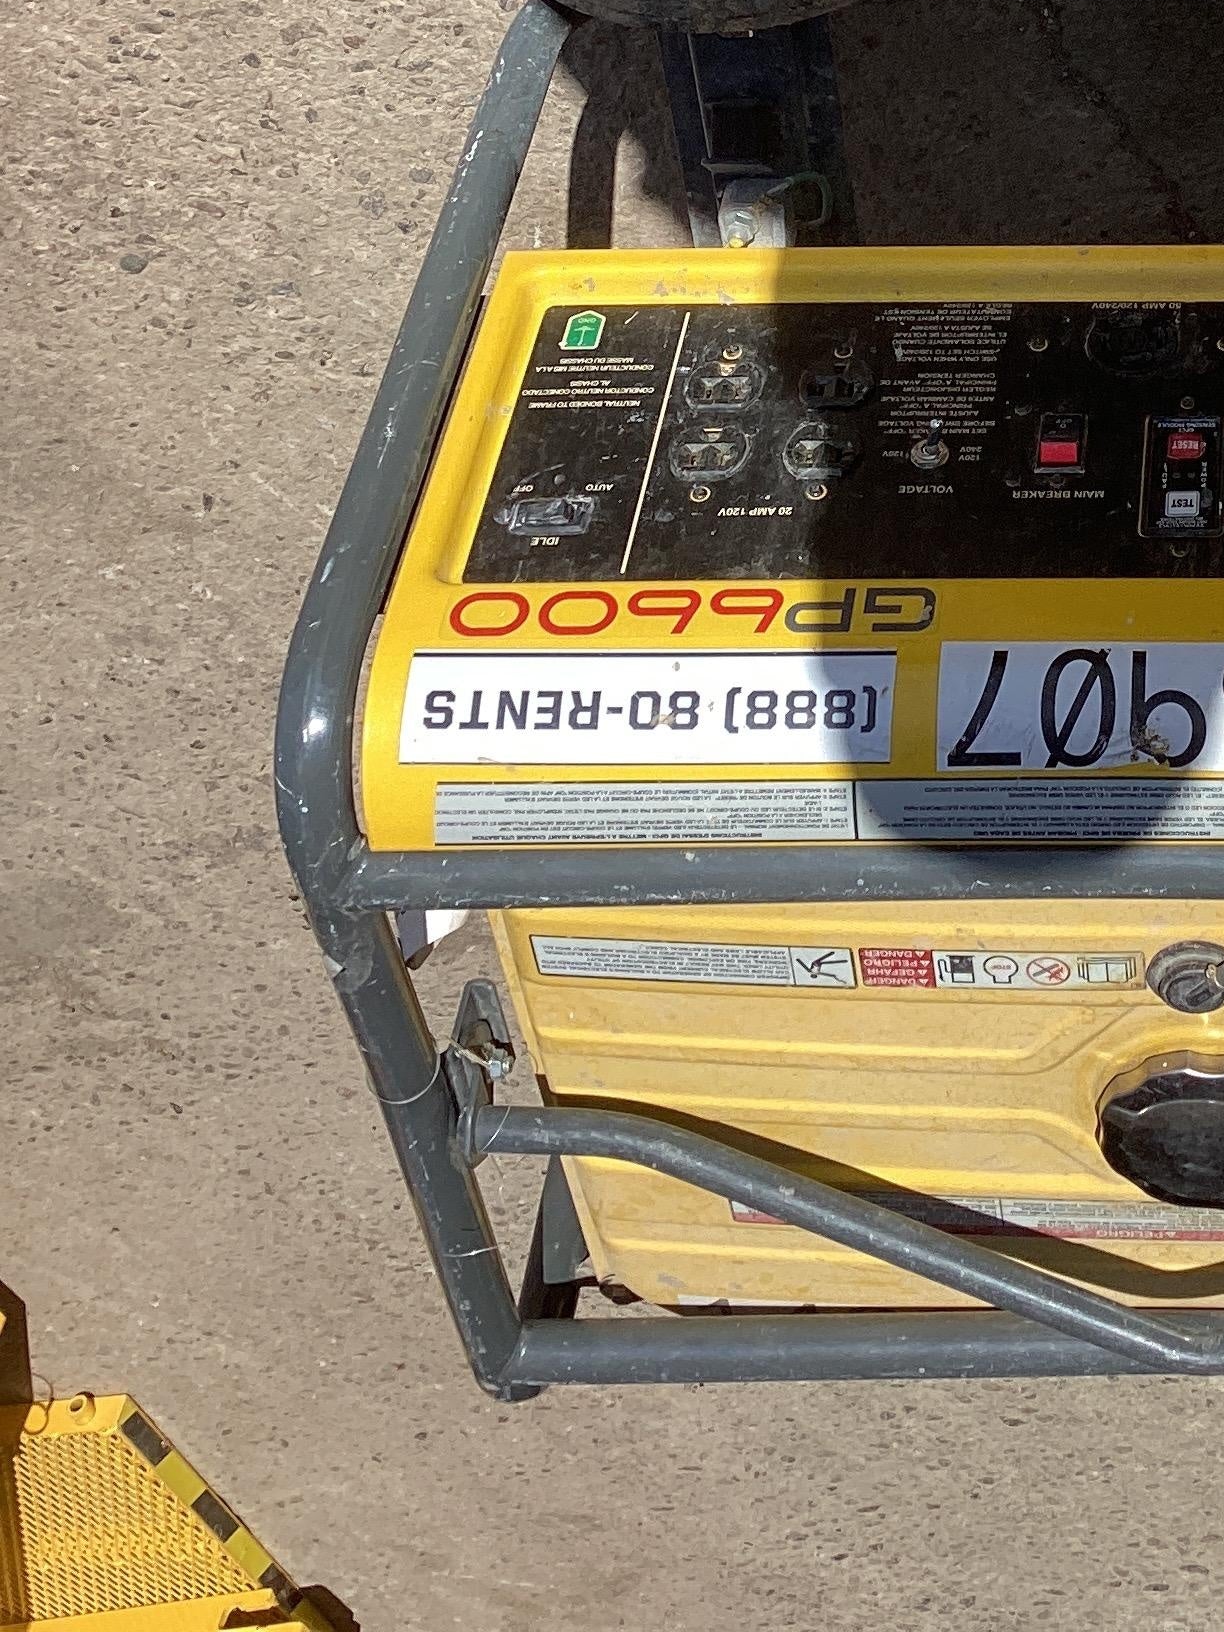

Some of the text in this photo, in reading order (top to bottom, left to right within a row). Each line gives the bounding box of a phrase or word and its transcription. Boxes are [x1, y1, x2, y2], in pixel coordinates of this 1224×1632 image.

[1172, 440, 1199, 449] RESET
[512, 483, 614, 492] AUTO OFF
[898, 485, 953, 494] VOLTAGE
[1012, 490, 1104, 498] MAIN BREAKER
[1171, 499, 1194, 507] TEST
[716, 506, 793, 517] 20 AMP 120V
[530, 537, 560, 546] IDLE
[449, 586, 937, 637] GP6600
[422, 687, 876, 734] (888) 80-RENTS
[864, 959, 918, 967] PELIGRO
[867, 968, 916, 976] GEFAHR
[864, 978, 916, 986] DANGER
